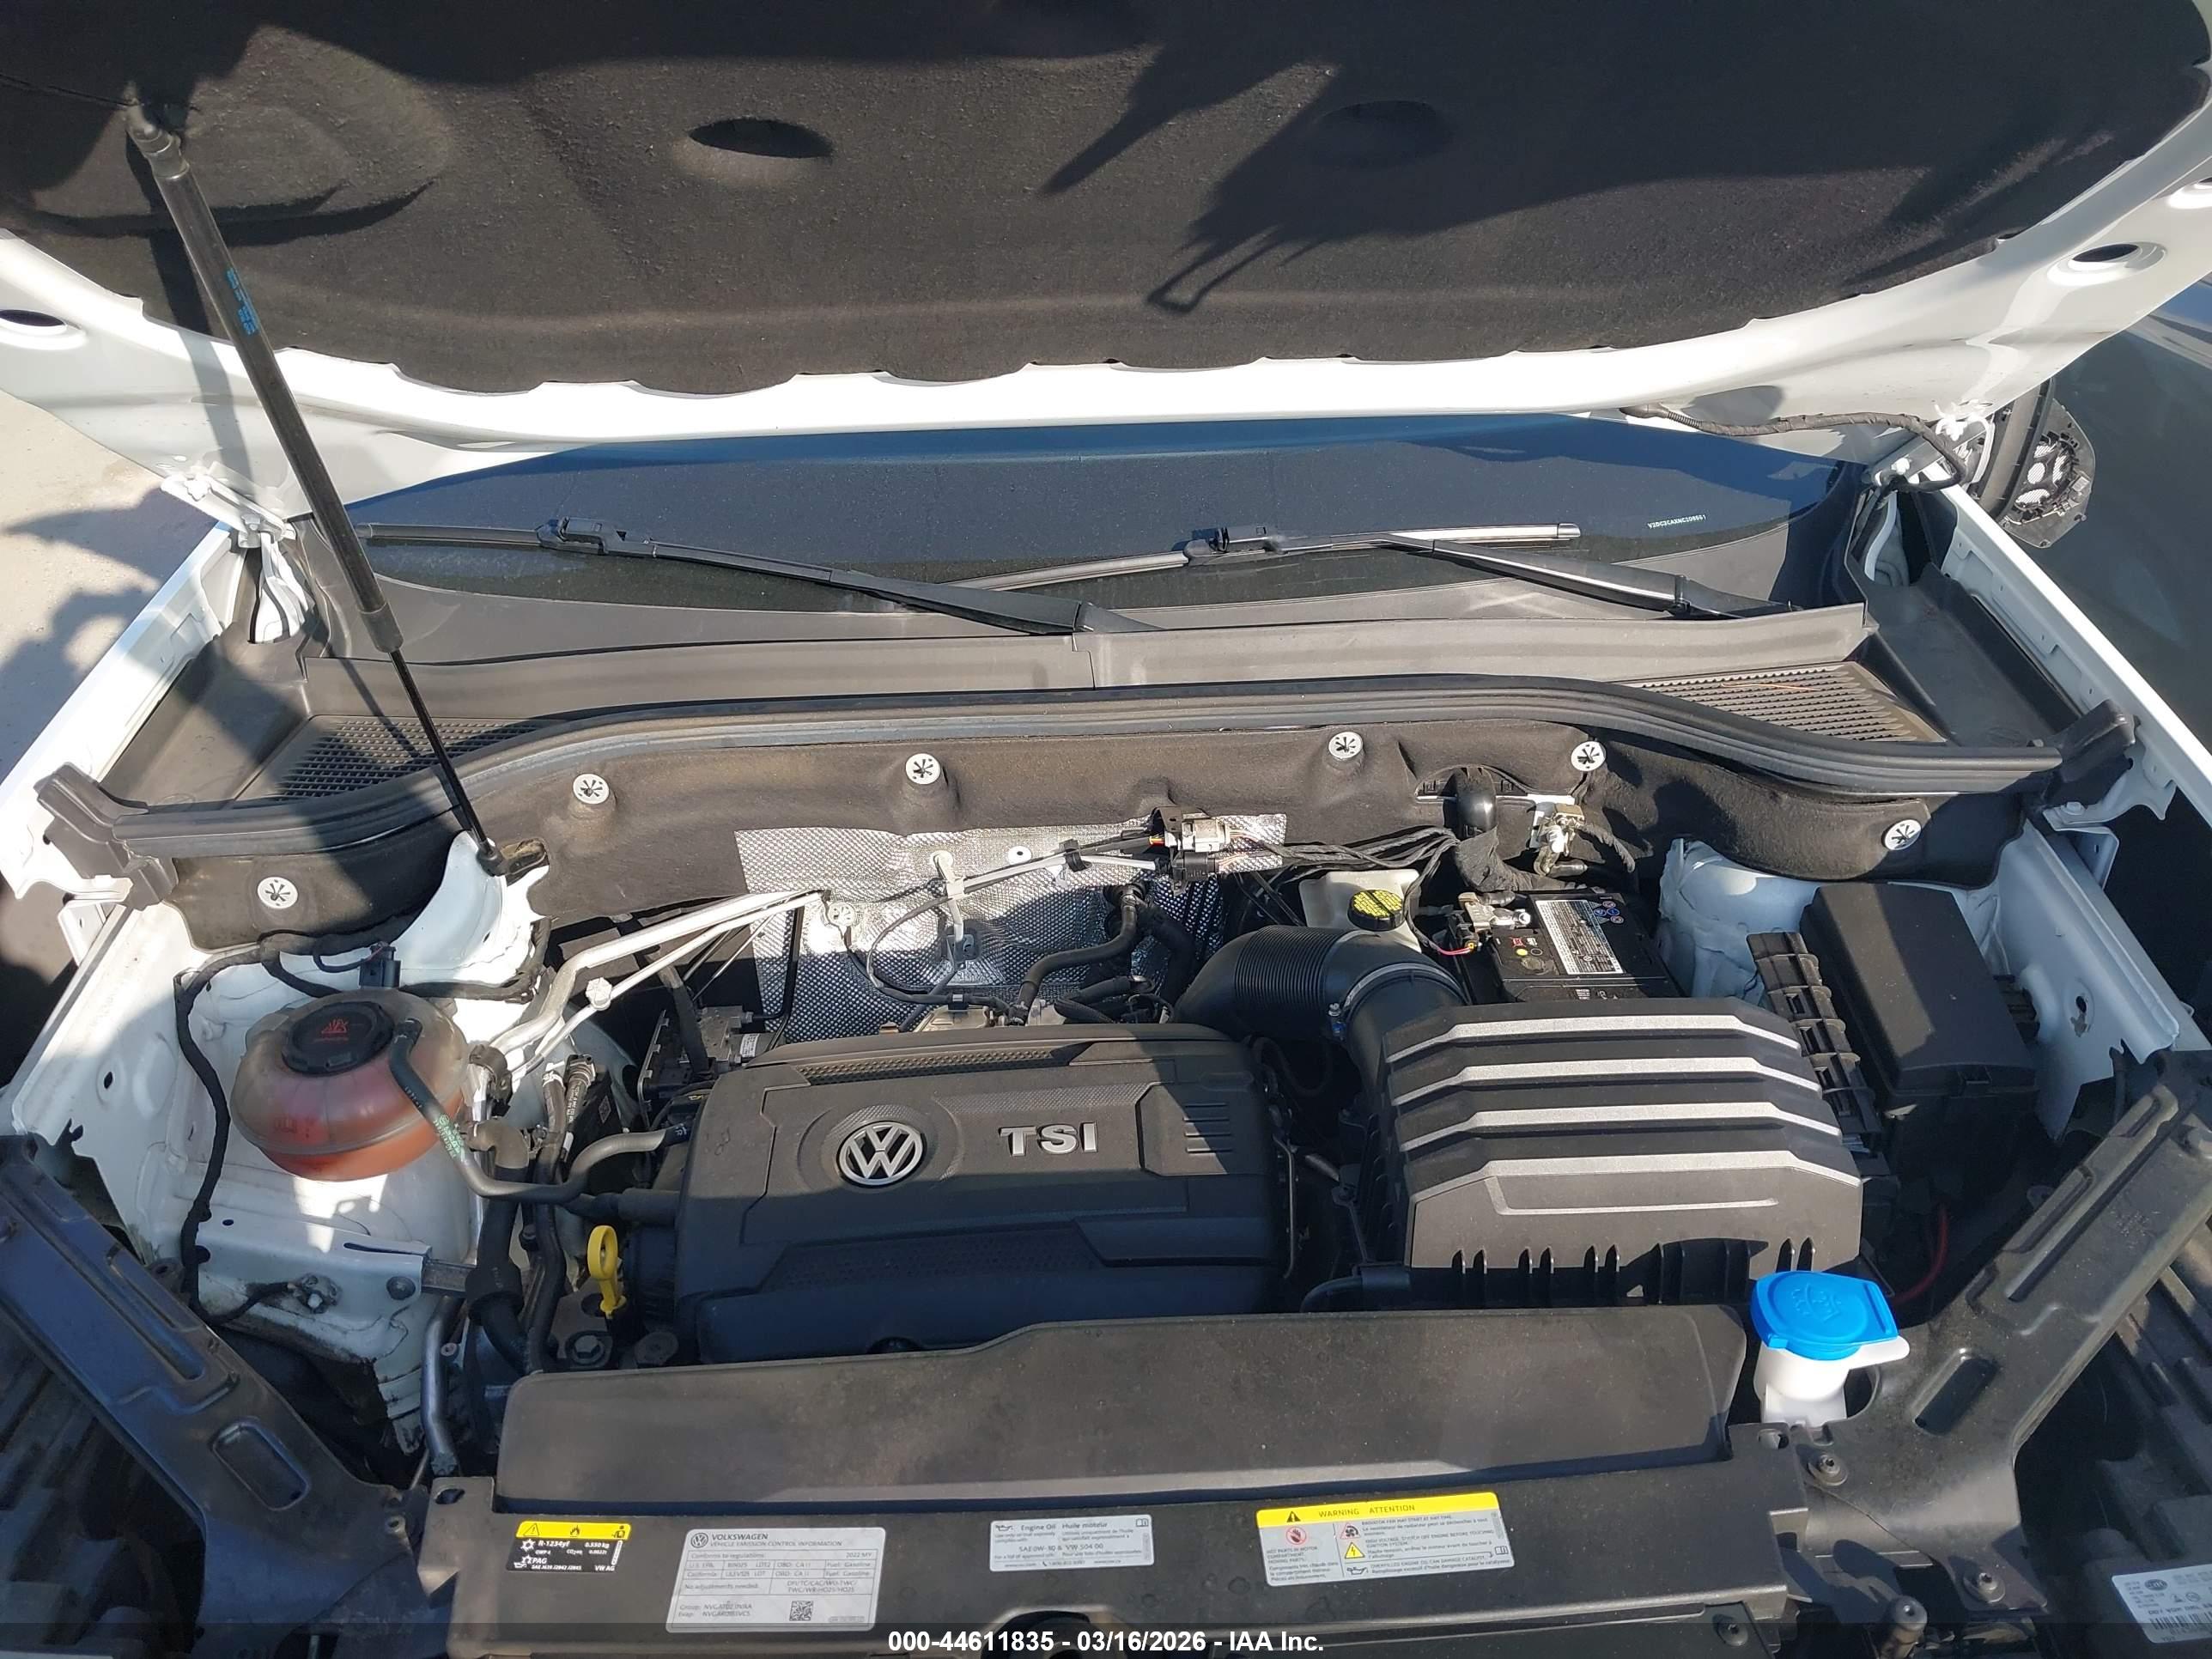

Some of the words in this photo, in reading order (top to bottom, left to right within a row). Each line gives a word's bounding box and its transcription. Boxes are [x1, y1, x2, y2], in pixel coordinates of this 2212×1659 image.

[1000, 1121, 1098, 1158] TSI
[1318, 1508, 1359, 1518] WARNING
[1369, 1504, 1415, 1514] ATTENTION
